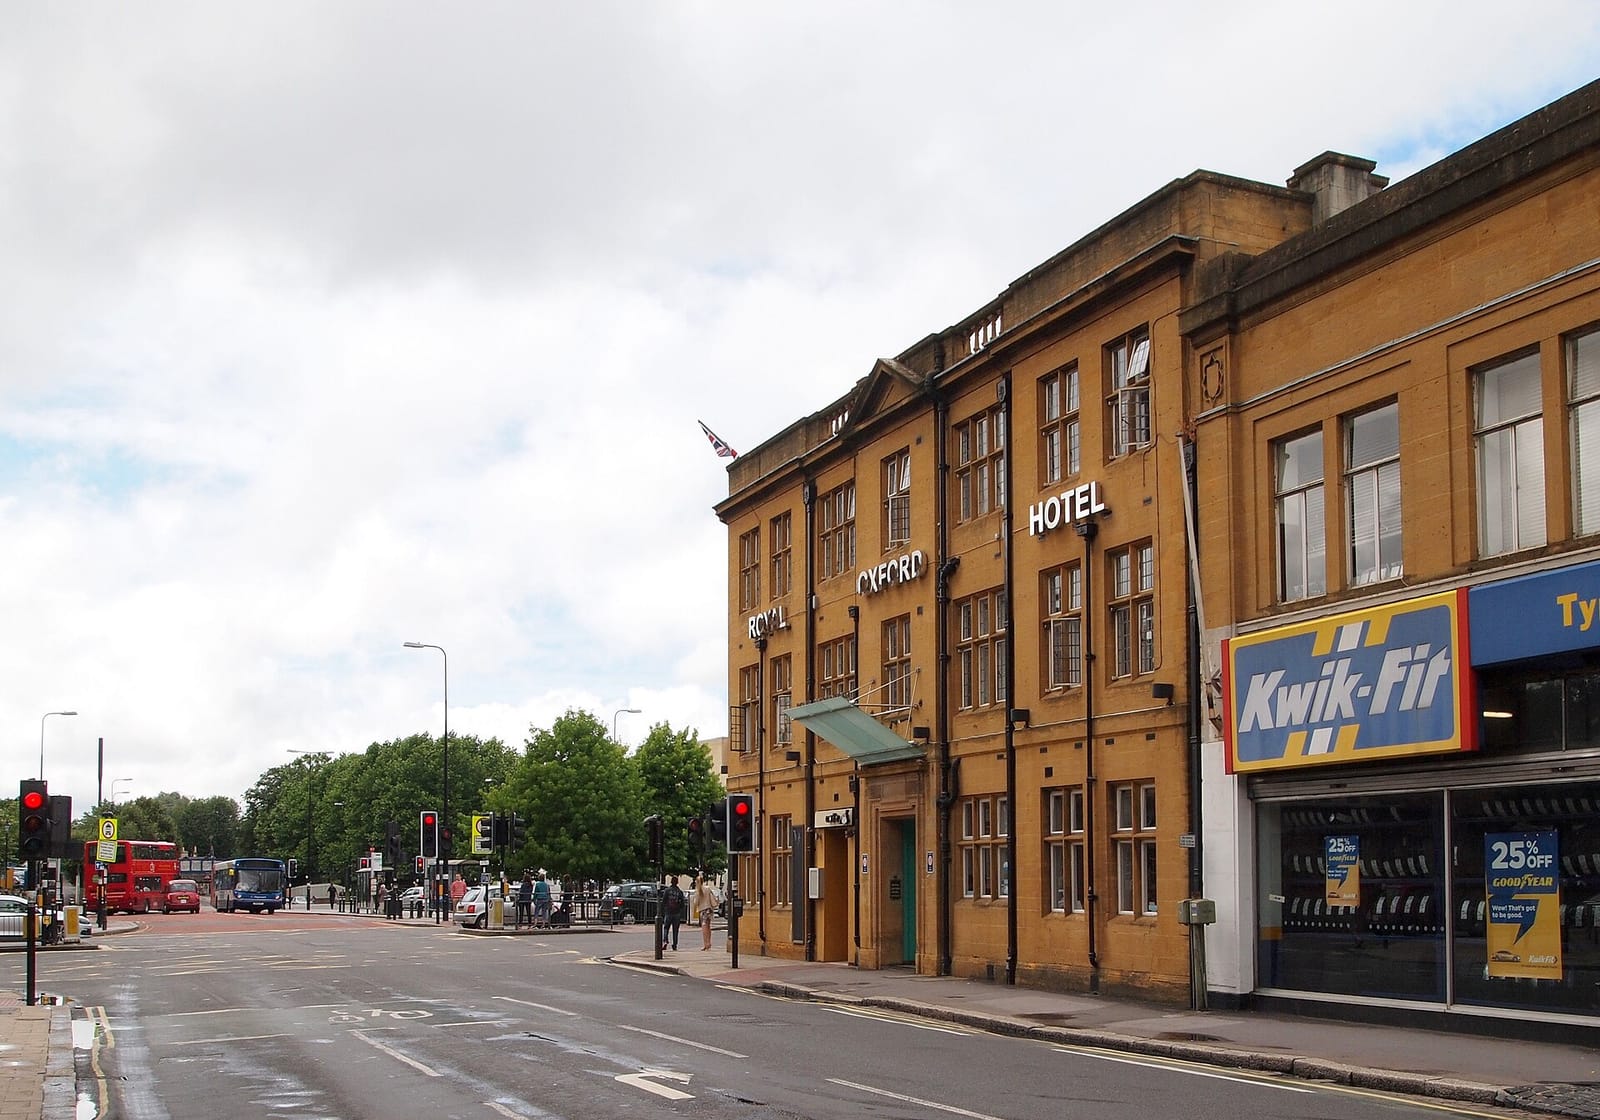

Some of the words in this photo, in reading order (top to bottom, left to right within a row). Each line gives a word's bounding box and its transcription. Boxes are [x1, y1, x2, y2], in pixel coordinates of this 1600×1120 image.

[748, 605, 787, 639] ROYAL
[857, 550, 924, 594] OXFORD
[1029, 481, 1105, 537] HOTEL
[1556, 592, 1600, 631] Ty
[1238, 643, 1451, 733] Kwik-Fit
[1328, 838, 1350, 853] 25%
[1344, 845, 1356, 853] OFF
[1491, 840, 1539, 869] 25%
[1527, 855, 1553, 868] OFF
[1492, 874, 1553, 889] GOODYEAR
